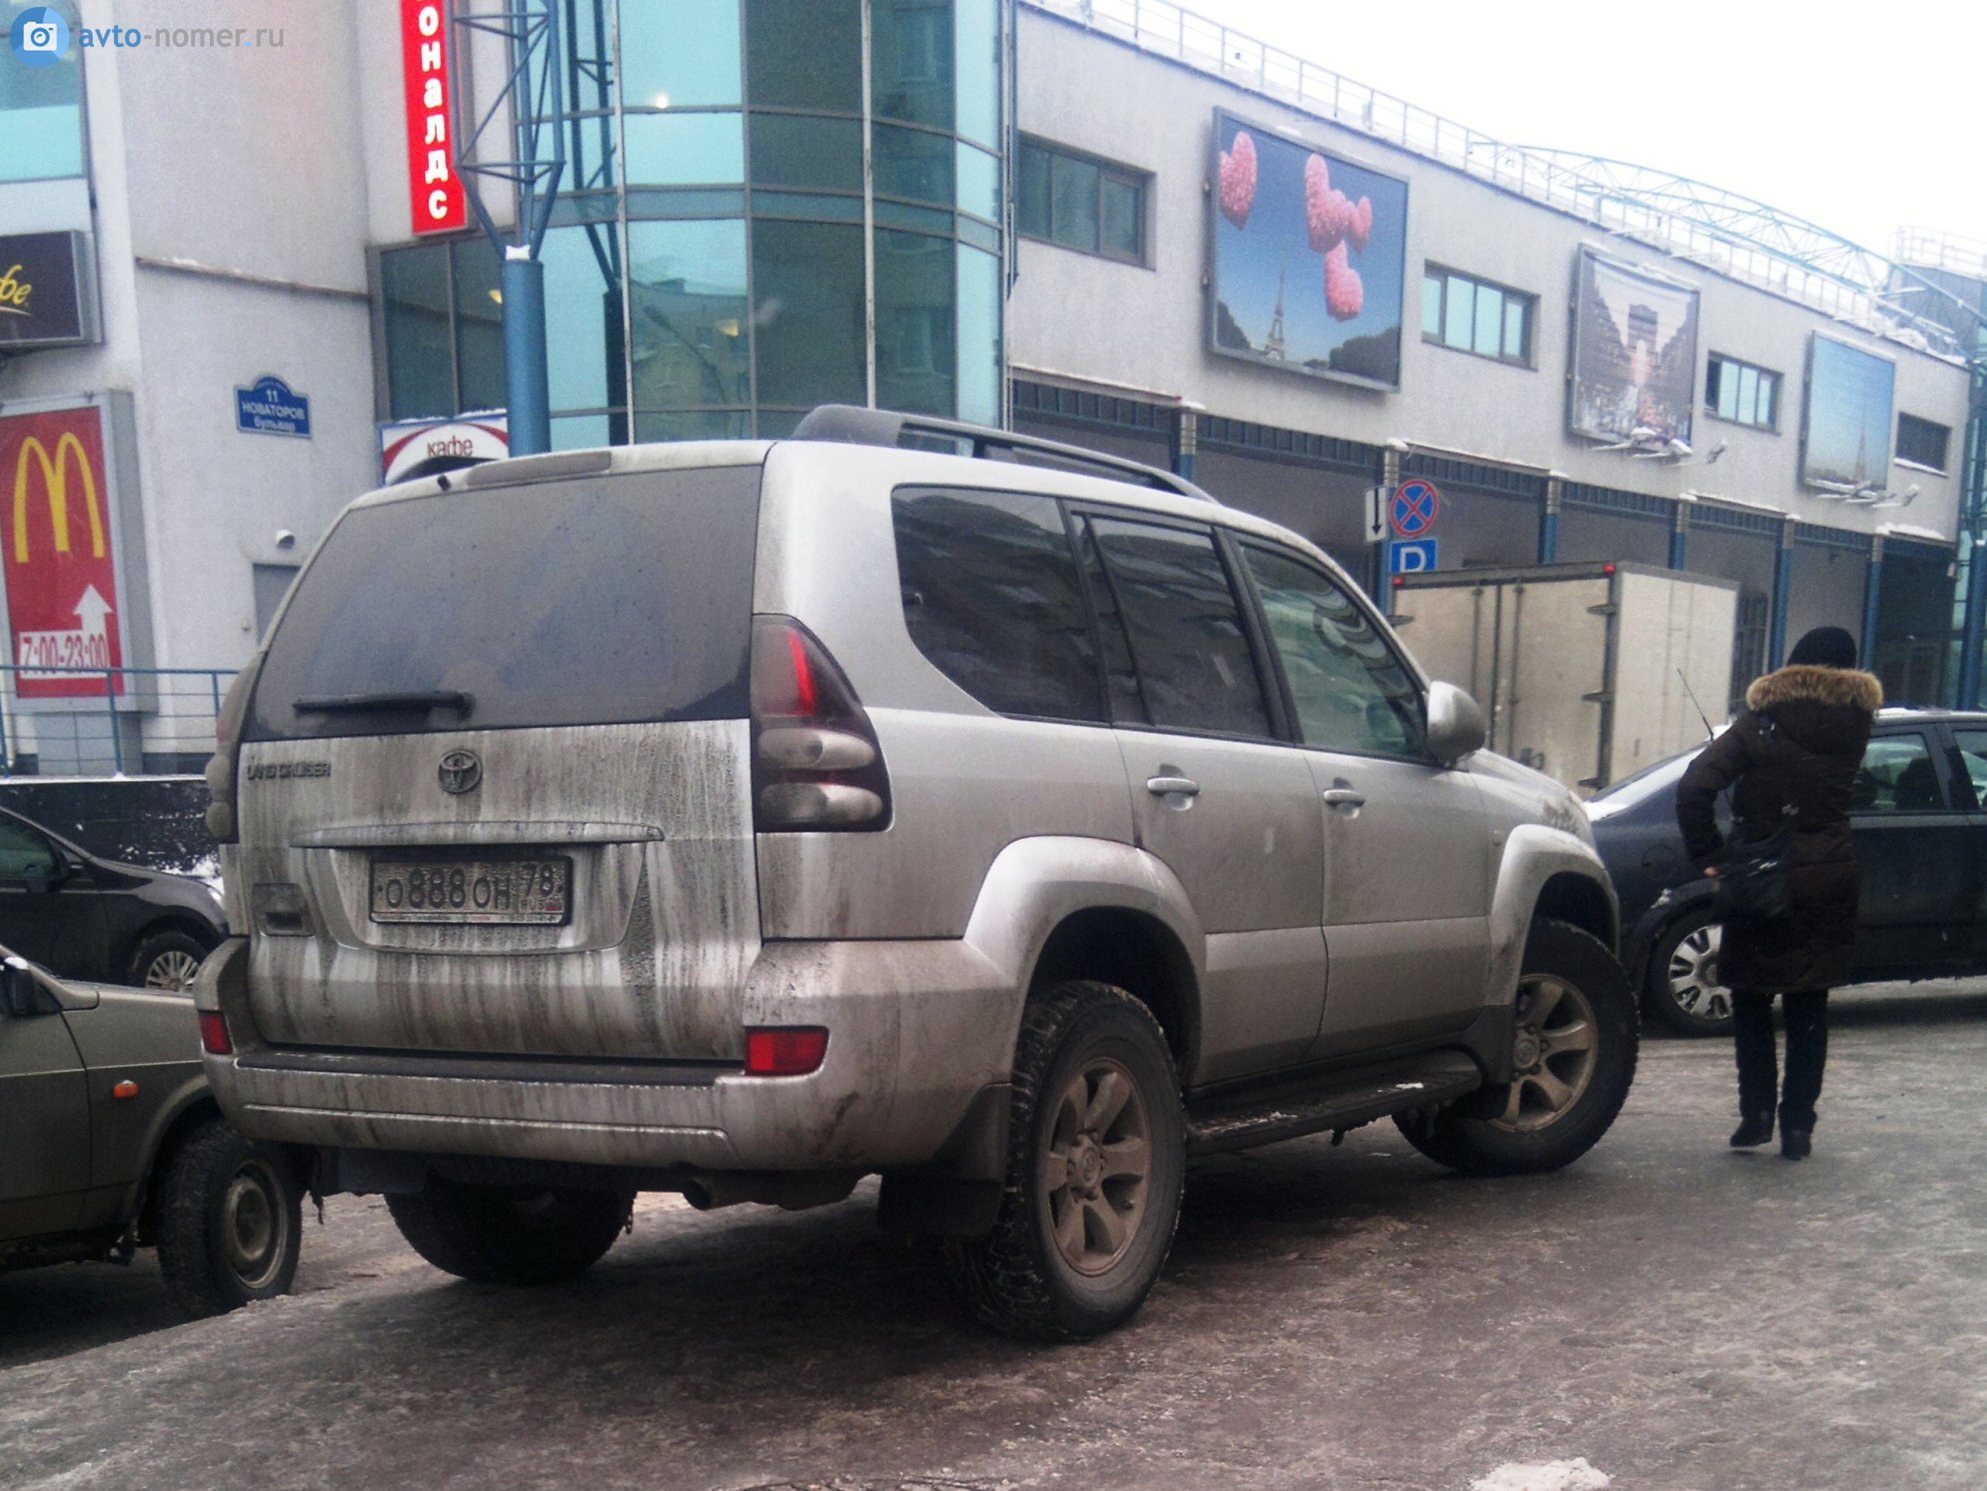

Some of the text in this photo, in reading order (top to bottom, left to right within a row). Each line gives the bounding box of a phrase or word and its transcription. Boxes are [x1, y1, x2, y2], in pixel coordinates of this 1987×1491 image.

[416, 0, 449, 219] оналдс
[266, 389, 278, 403] 11
[242, 401, 305, 420] НОВАТОРОВ
